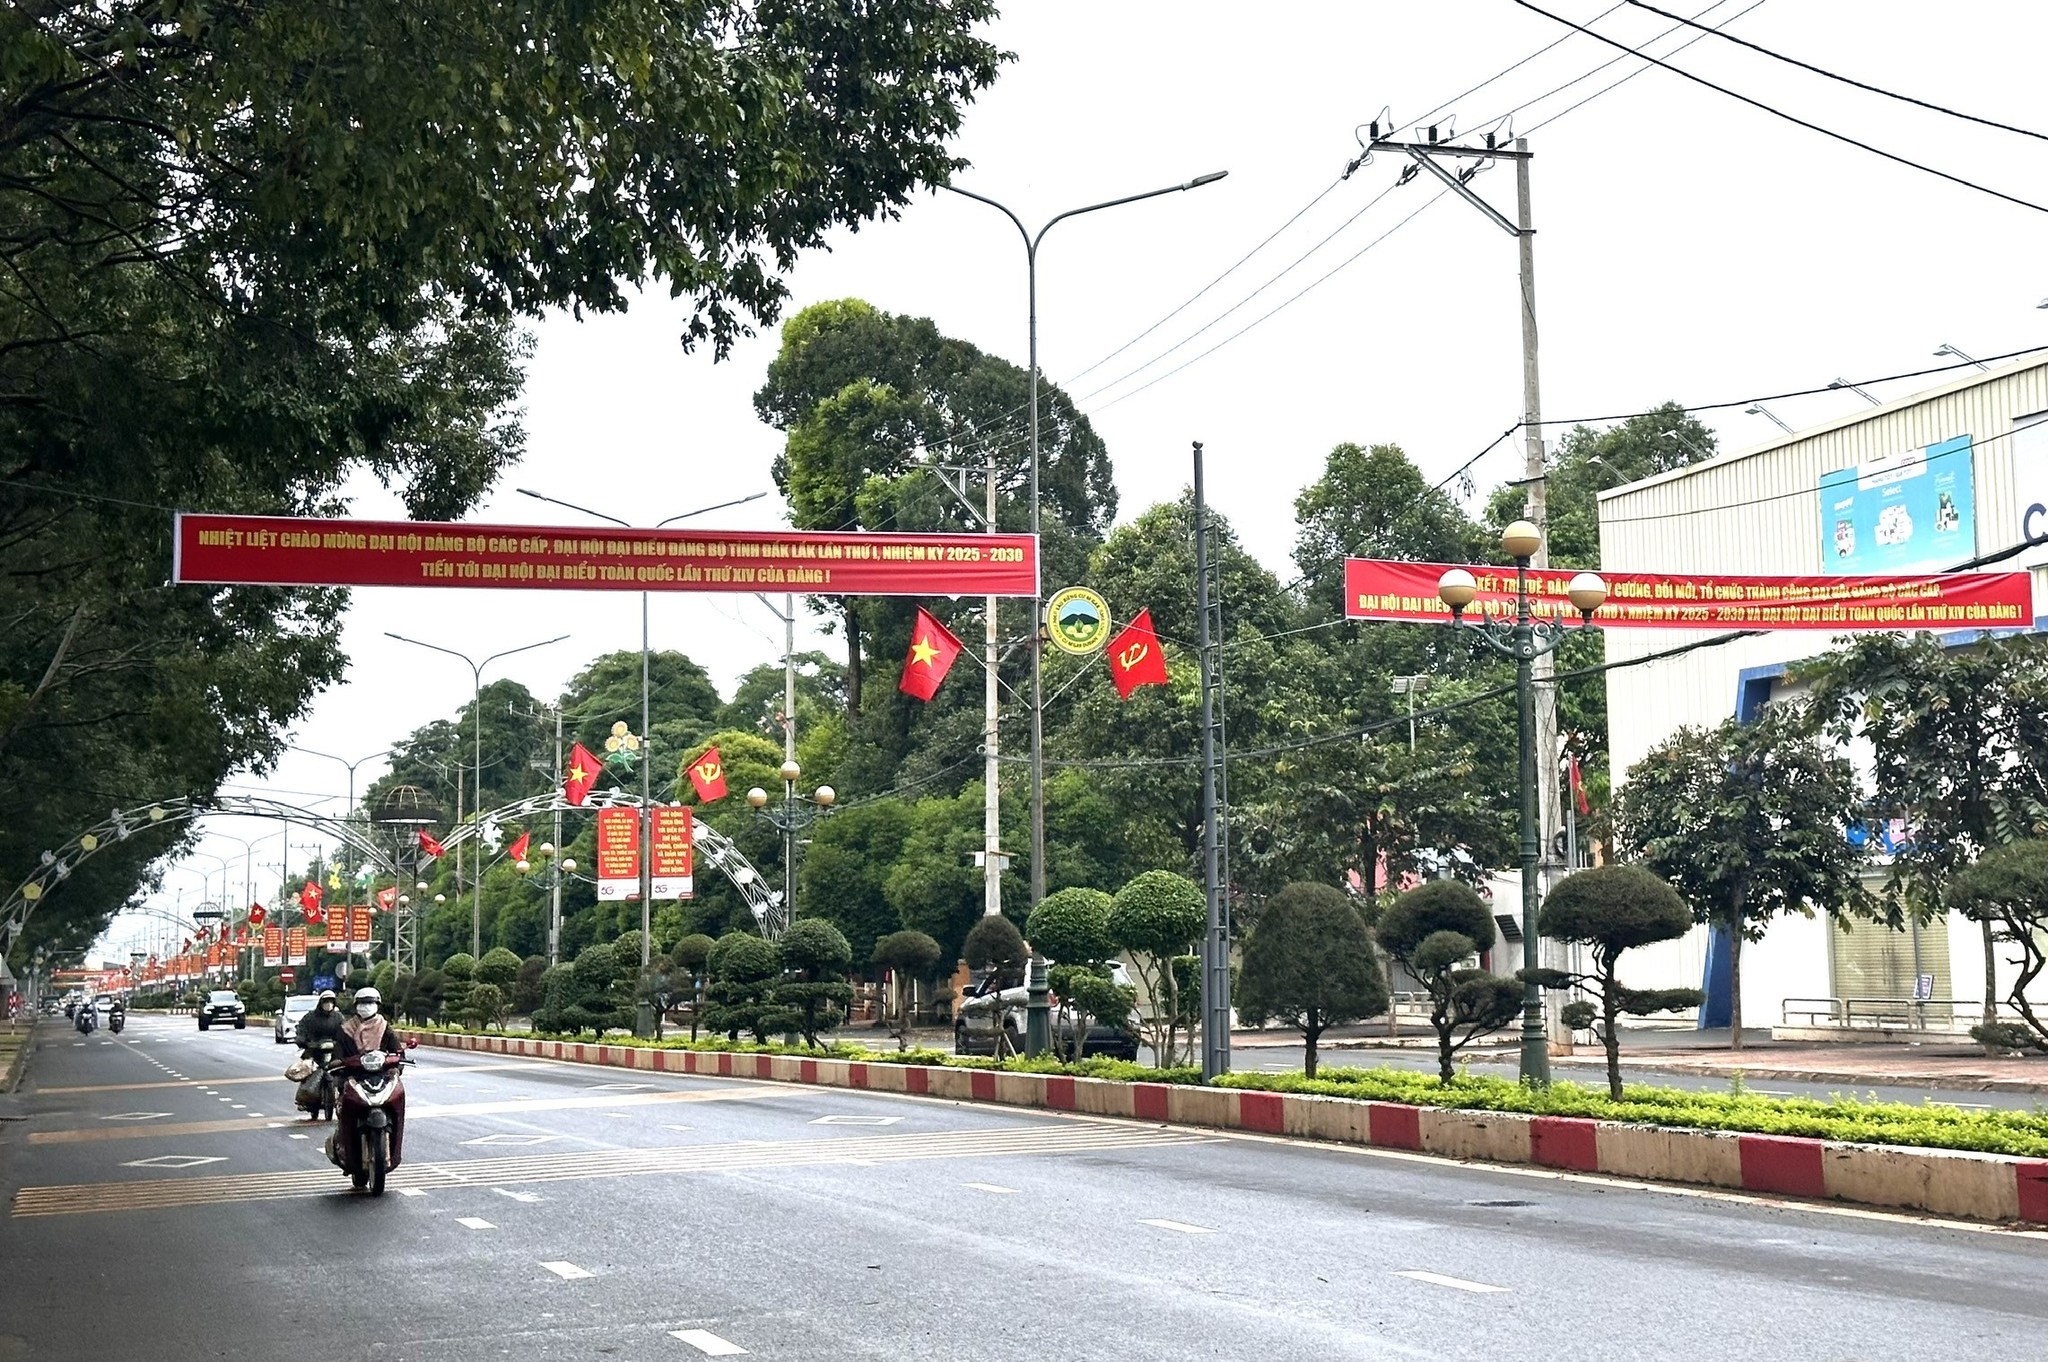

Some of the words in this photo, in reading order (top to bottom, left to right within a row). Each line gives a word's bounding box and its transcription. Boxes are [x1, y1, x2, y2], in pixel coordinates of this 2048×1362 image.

[198, 528, 244, 550] NHIỆT
[246, 528, 277, 550] LIỆT
[280, 530, 320, 548] CHÀO
[324, 530, 366, 550] MỪNG
[370, 535, 394, 552] ĐẠI
[397, 533, 422, 554] HỘI
[425, 532, 464, 552] ĐẢNG
[466, 534, 486, 555] BỘ
[489, 535, 518, 553] CÁC
[554, 539, 578, 556] ĐẠI
[580, 538, 604, 558] HỘI
[606, 540, 630, 558] ĐẠI
[633, 538, 666, 556] BIỂU
[668, 540, 706, 556] ĐẢNG
[708, 541, 726, 560] BỘ
[844, 542, 872, 559] THỨ
[882, 544, 925, 562] NHIỆM
[928, 544, 944, 560] KỲ
[947, 547, 980, 562] 2025
[990, 548, 1023, 562] 2030
[420, 559, 454, 576] TIẾN
[482, 564, 506, 581] ĐẠI
[510, 562, 534, 582] HỘI
[536, 564, 560, 582] ĐẠI
[564, 560, 596, 580] BIỂU
[599, 563, 634, 580] TOÀN
[638, 563, 674, 582] QUỐC
[704, 564, 732, 582] THỨ
[733, 568, 755, 582] XIV
[758, 565, 784, 582] CỦA
[787, 566, 823, 582] ĐẢNG
[1700, 580, 1713, 600] TỔ
[1359, 594, 1378, 612] ĐẠI
[1380, 593, 1400, 613] HỘI
[1402, 597, 1422, 614] ĐẠI
[1680, 608, 1709, 620] 2025
[1717, 607, 1744, 620] 2030
[1849, 604, 1875, 620] TOÀN
[1877, 604, 1904, 622] QUỐC
[1926, 604, 1948, 620] THỨ
[1948, 606, 1965, 620] XIV
[1966, 602, 1987, 619] CỦA
[1988, 601, 2016, 618] ĐẢNG
[601, 886, 614, 895] 5G
[655, 884, 668, 894] 5G
